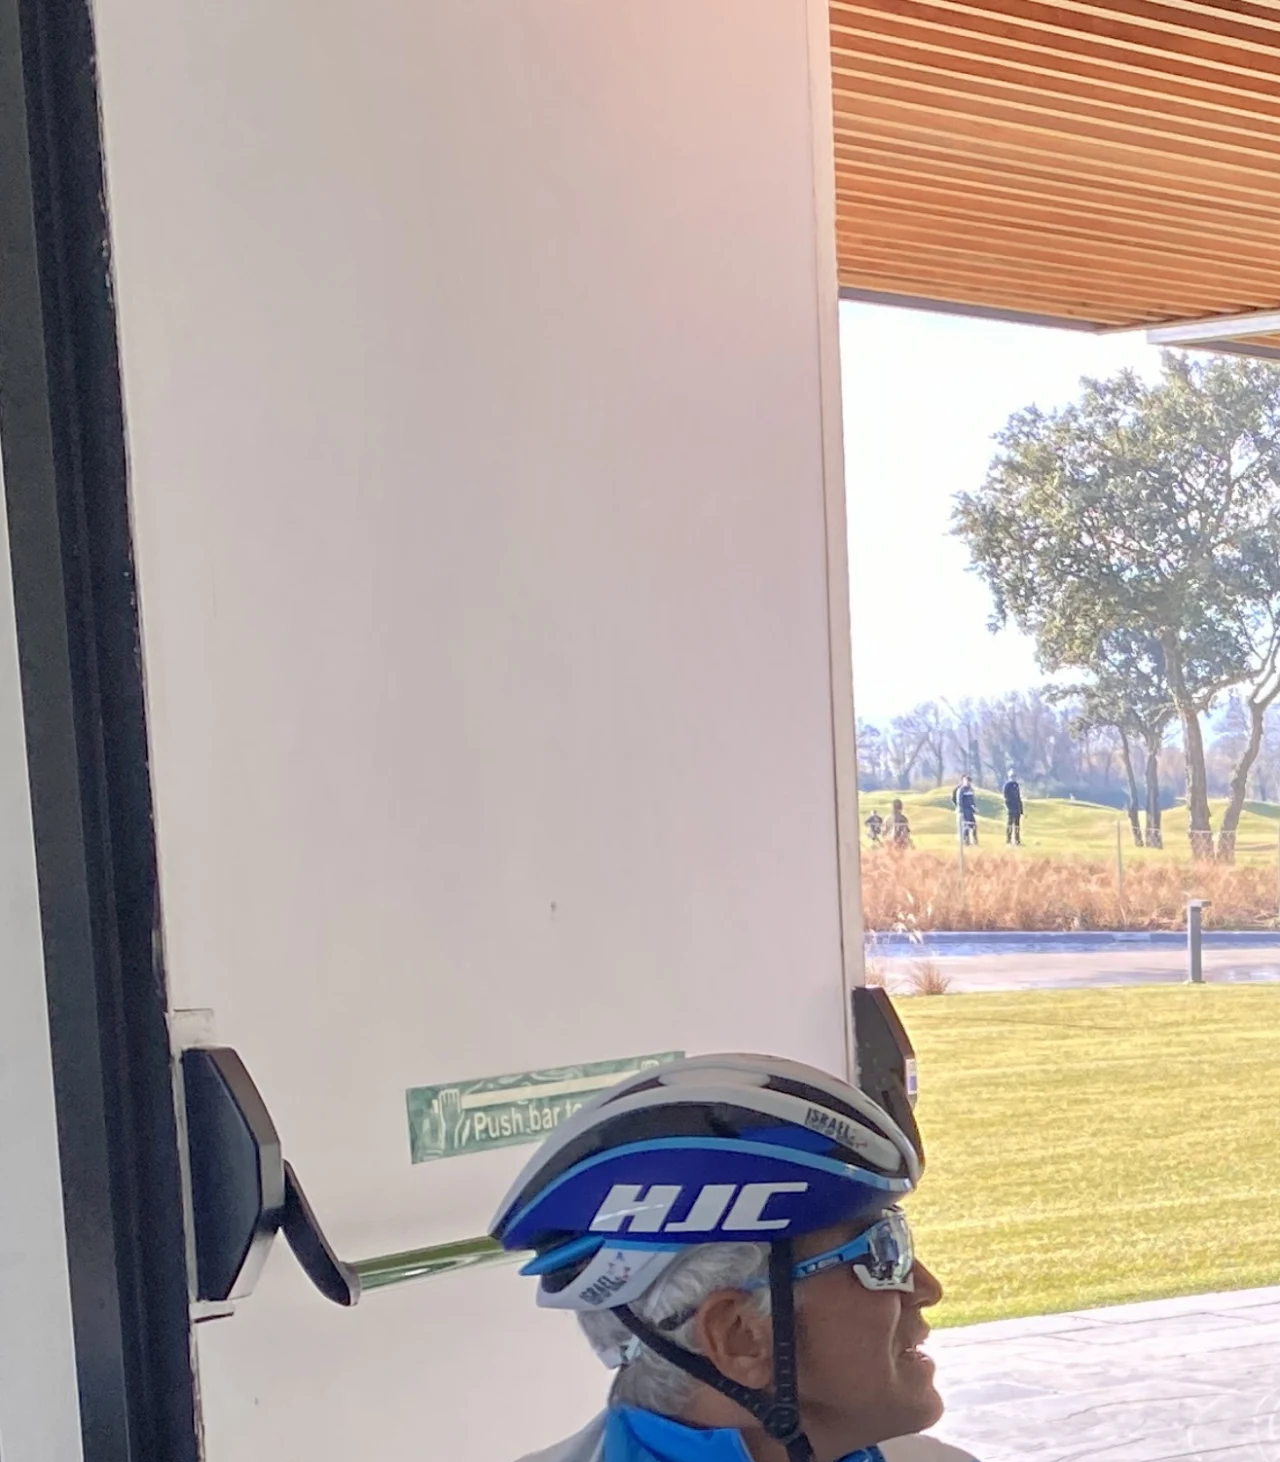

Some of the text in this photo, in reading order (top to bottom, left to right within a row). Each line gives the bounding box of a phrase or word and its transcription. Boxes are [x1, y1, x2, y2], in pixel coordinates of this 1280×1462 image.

[473, 1108, 525, 1141] Push
[529, 1104, 560, 1131] bar
[806, 1107, 852, 1140] ISRAEL
[589, 1182, 808, 1232] HJC
